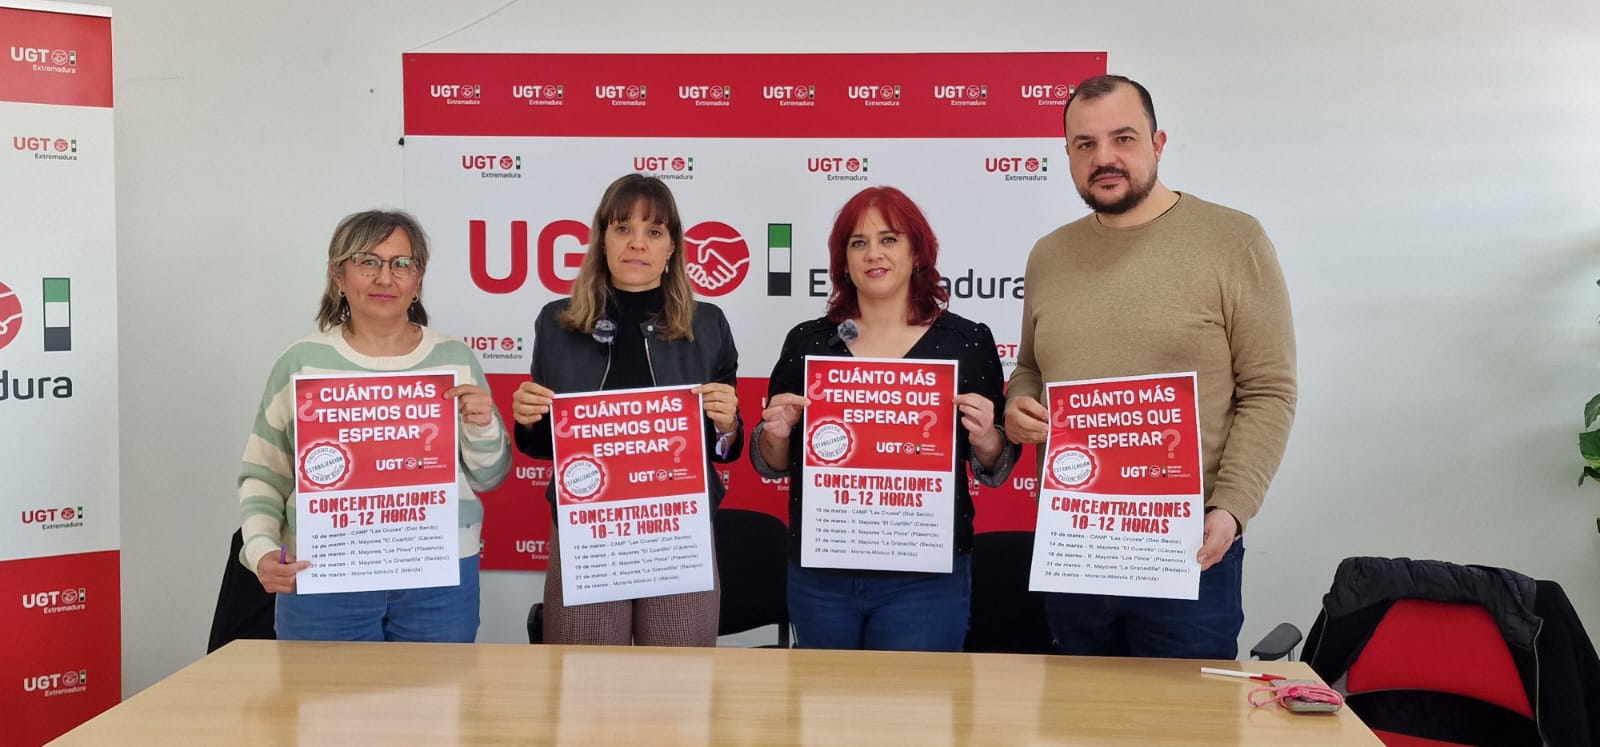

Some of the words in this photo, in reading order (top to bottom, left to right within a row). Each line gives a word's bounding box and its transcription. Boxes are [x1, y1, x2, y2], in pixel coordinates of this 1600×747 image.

[10, 46, 50, 64] UGT
[430, 85, 460, 98] UGT
[512, 85, 542, 98] UGT
[596, 86, 625, 98] UGT
[678, 86, 708, 99] UGT
[763, 86, 793, 99] UGT
[848, 86, 879, 99] UGT
[934, 86, 965, 99] UGT
[1022, 85, 1052, 98] UGT
[13, 136, 51, 152] UGT
[462, 156, 496, 170] UGT
[634, 157, 668, 171] UGT
[808, 158, 842, 172] UGT
[985, 158, 1022, 172] UGT
[469, 220, 591, 295] UG
[996, 344, 1018, 358] GT
[828, 367, 895, 385] CUÁNTO
[900, 369, 936, 386] MÁS
[320, 384, 393, 402] CUÁNTO
[398, 382, 436, 398] MÁS
[824, 389, 902, 405] TENEMOS
[906, 391, 940, 406] QUE
[1070, 390, 1134, 408] CUÁNTO
[1139, 384, 1175, 404] MÁS
[316, 406, 400, 423] TENEMOS
[406, 404, 440, 420] QUE
[574, 400, 642, 419] CUÁNTO
[646, 396, 682, 413] MÁS
[843, 409, 919, 425] ESPERAR
[1067, 410, 1143, 429] TENEMOS
[1147, 408, 1182, 425] QUE
[338, 425, 420, 443] ESPERAR
[571, 420, 650, 439] TENEMOS
[654, 417, 688, 434] QUE
[593, 438, 670, 457] ESPERAR
[876, 442, 902, 454] UGT
[1088, 431, 1163, 449] ESPERAR
[376, 458, 403, 471] UGT
[516, 466, 545, 479] UGT
[1121, 466, 1148, 478] UGT
[629, 470, 654, 483] UGT
[814, 474, 943, 492] CONCENTRACIONES
[309, 490, 446, 514] CONCENTRACIONES
[833, 490, 873, 506] 10-12
[880, 491, 923, 508] HORAS
[1051, 496, 1191, 518] CONCENTRACIONES
[21, 508, 58, 524] UGT
[331, 512, 374, 529] 10-12
[381, 507, 426, 524] HORAS
[570, 500, 698, 525] CONCENTRACIONES
[590, 522, 631, 539] 10-12
[638, 517, 680, 535] HORAS
[1072, 514, 1115, 532] 10-12
[1121, 518, 1169, 534] HORAS
[516, 540, 544, 553] UGT
[22, 591, 60, 609] UGT
[24, 674, 61, 692] UGT
